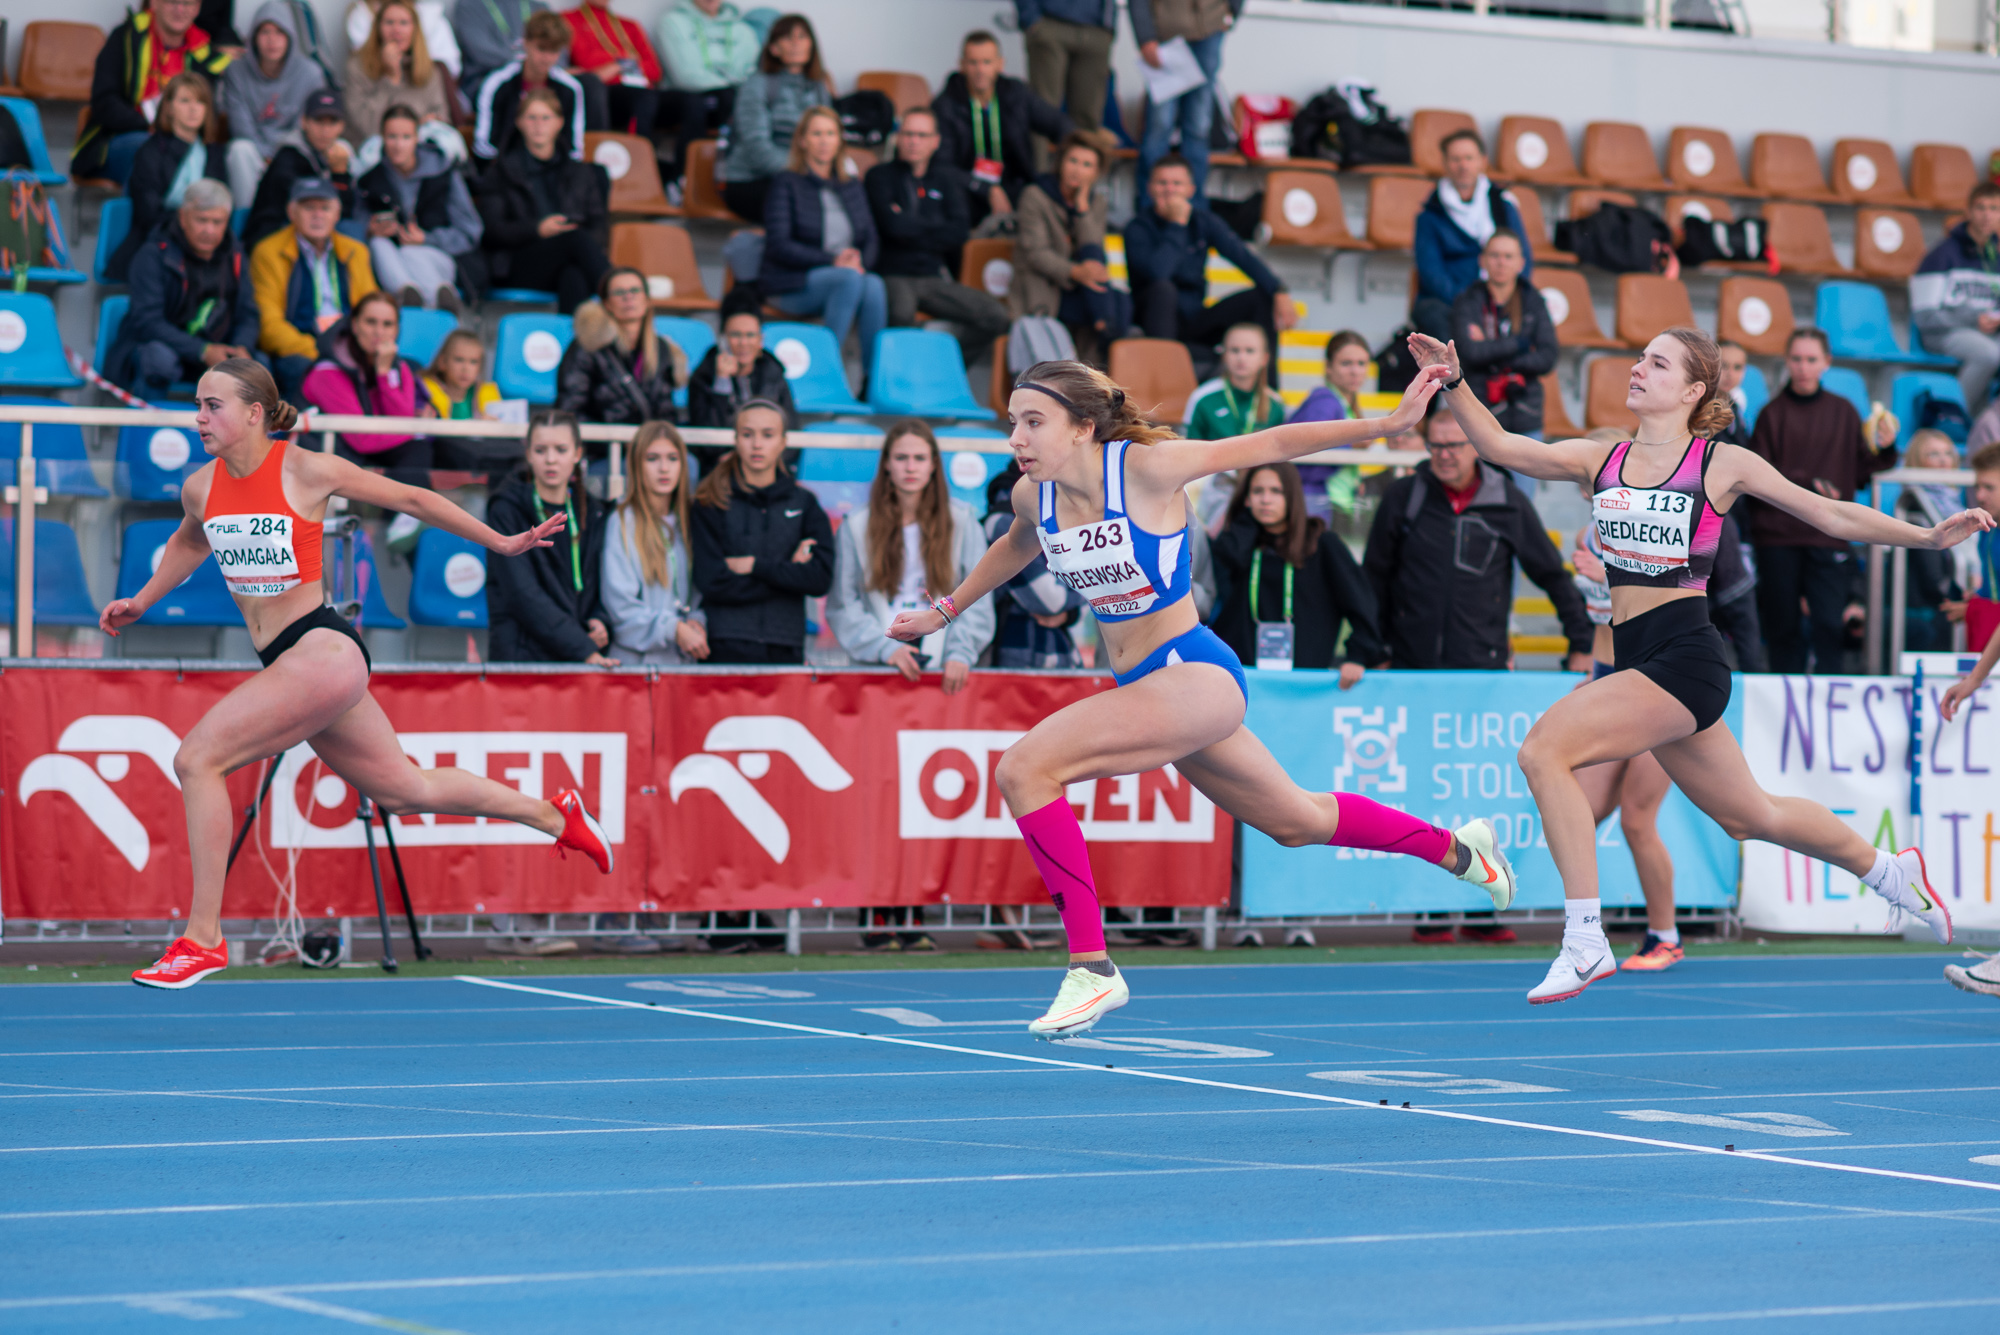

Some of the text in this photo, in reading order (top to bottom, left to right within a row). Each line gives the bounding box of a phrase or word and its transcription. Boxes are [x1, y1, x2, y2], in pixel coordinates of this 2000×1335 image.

[1601, 500, 1629, 509] ORLEN
[1646, 493, 1687, 513] 113
[216, 524, 243, 534] FUEL
[249, 517, 287, 536] 284
[1598, 519, 1684, 547] SIEDLECKA
[1078, 523, 1124, 552] 263
[214, 547, 293, 566] DOMAGAŁA
[1614, 555, 1642, 570] LUBLIN
[234, 583, 286, 593] LUBLIN 2022
[1112, 600, 1141, 613] 2022
